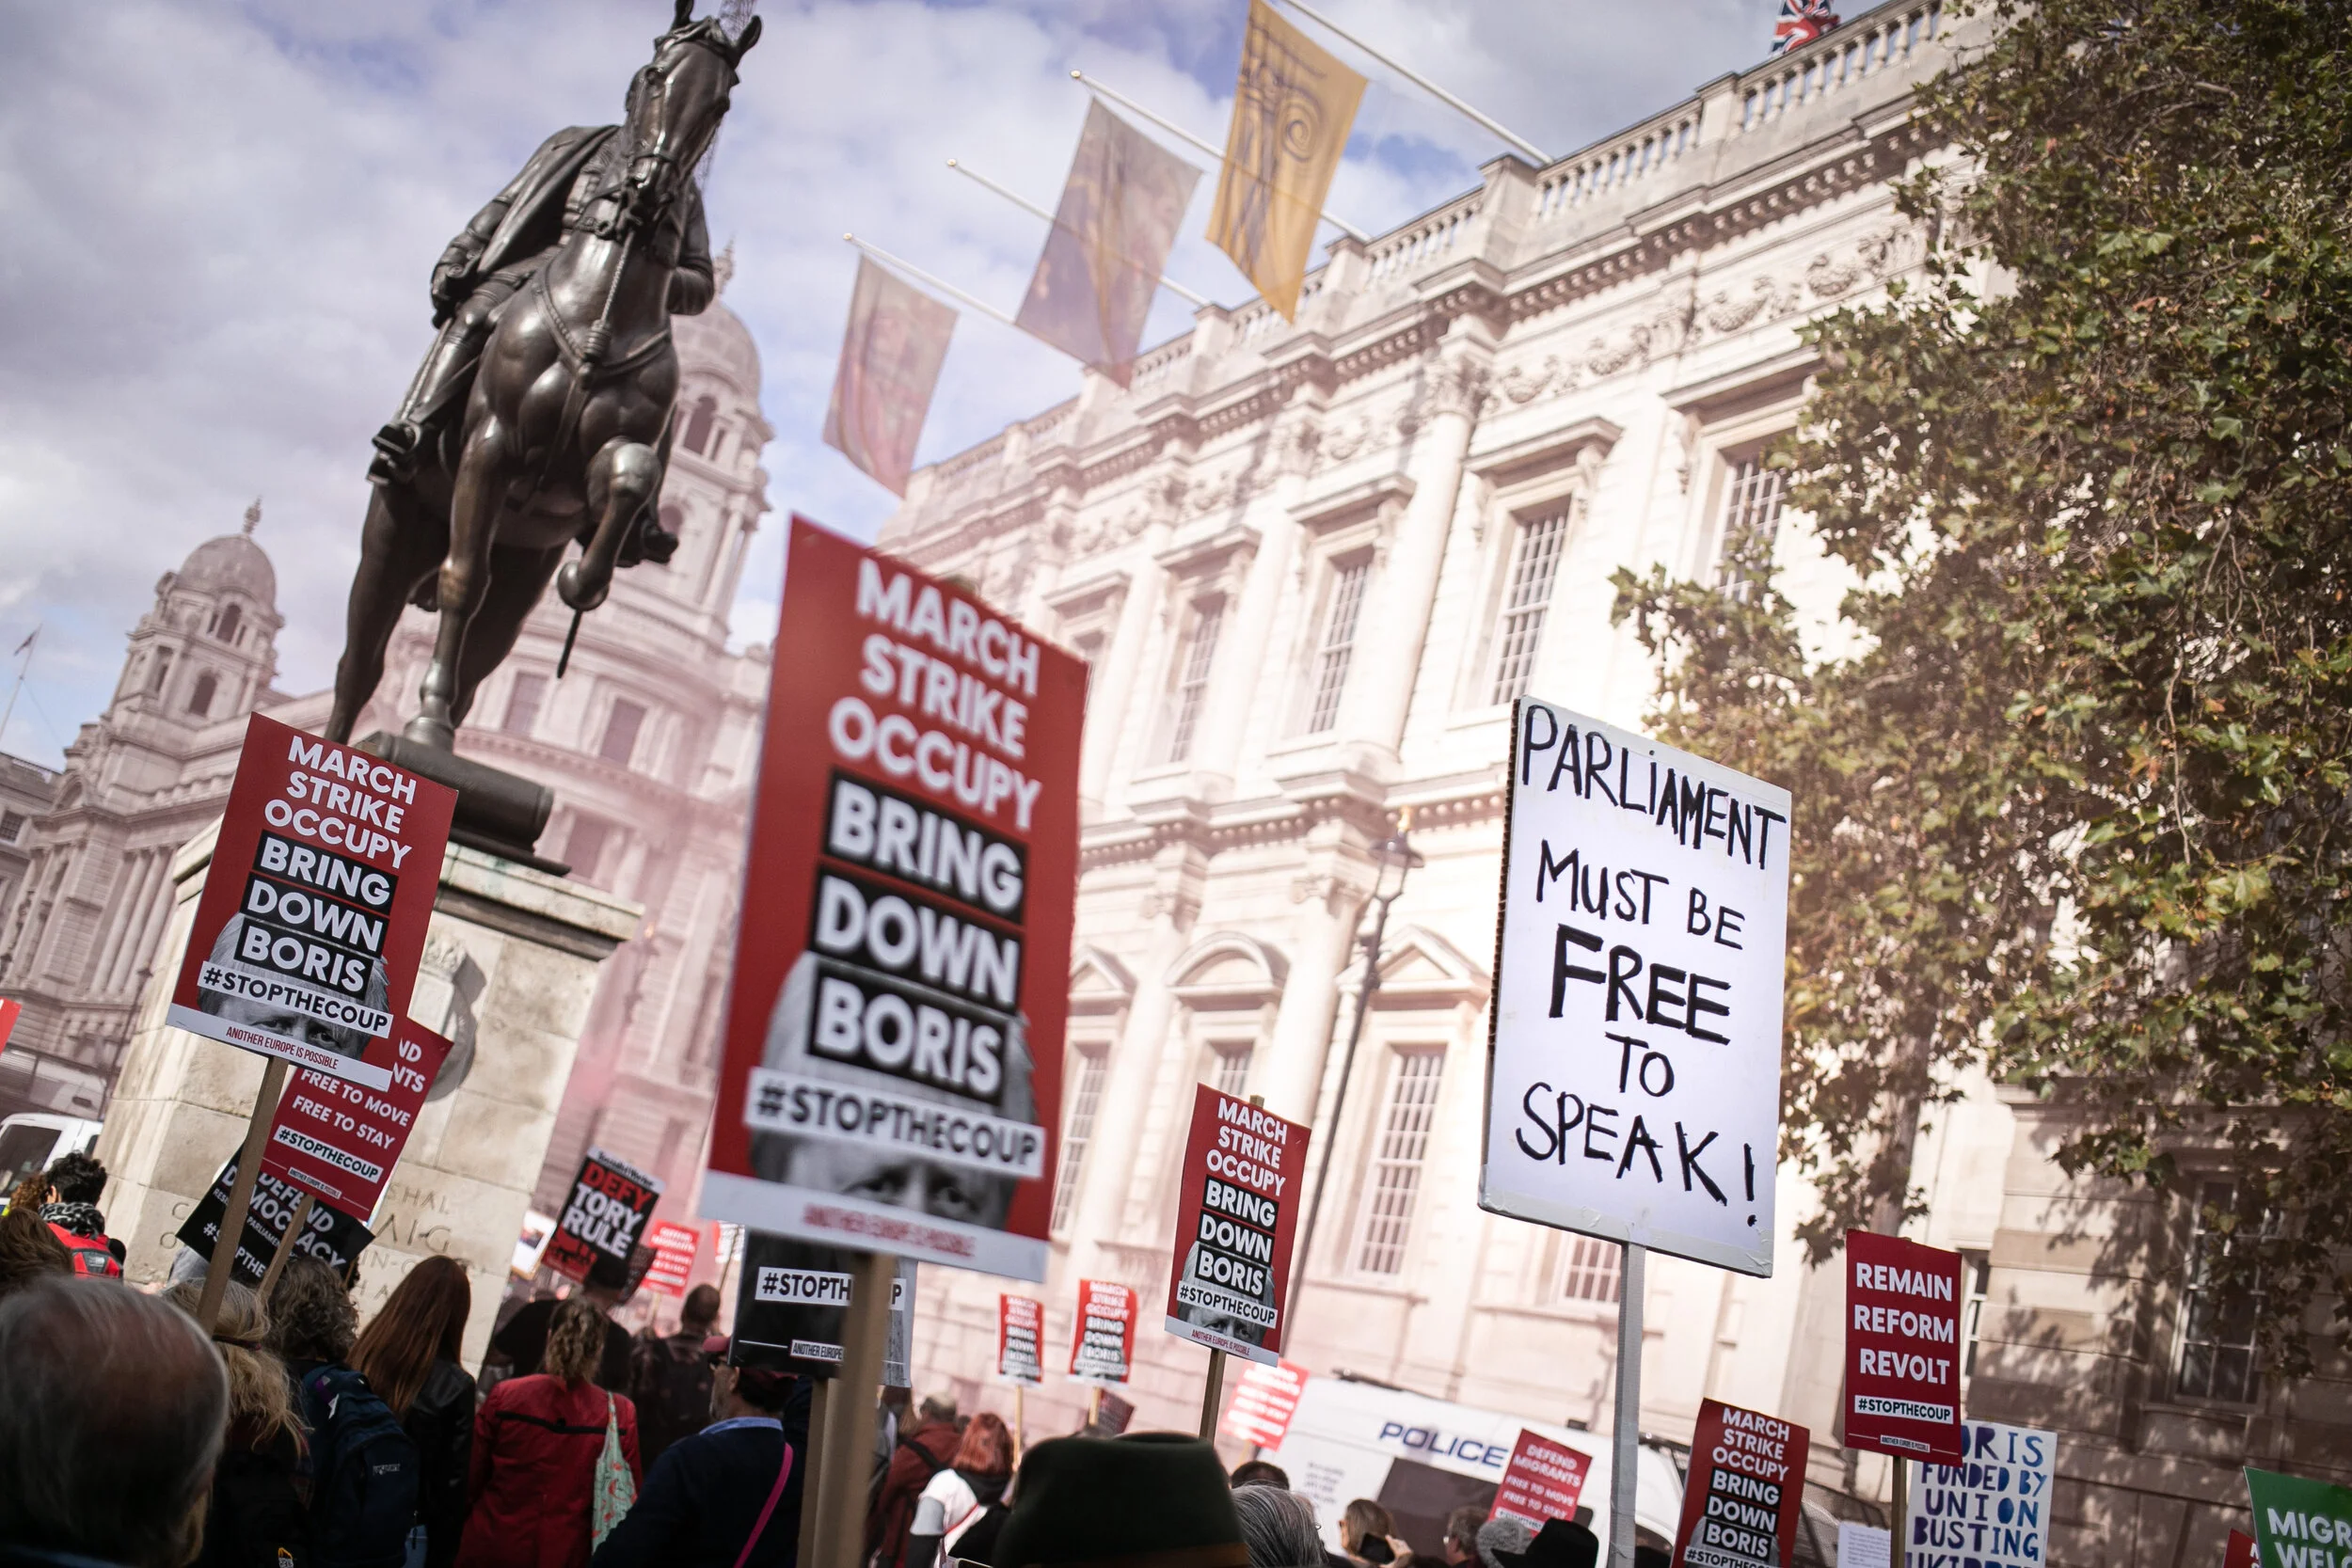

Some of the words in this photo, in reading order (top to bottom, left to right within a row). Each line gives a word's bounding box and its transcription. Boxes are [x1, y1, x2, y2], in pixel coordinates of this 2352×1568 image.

[858, 558, 1040, 695] MARCH
[860, 634, 1027, 758] STRIKE
[288, 736, 417, 804] MARCH
[829, 697, 1041, 830] OCCUPY
[286, 771, 405, 834] STRIKE
[264, 799, 412, 868] OCCUPY
[830, 779, 1023, 911] BRING
[261, 836, 390, 906] BRING
[1536, 838, 1669, 925] MUST
[1687, 887, 1745, 950] BE
[247, 879, 384, 952] DOWN
[242, 926, 365, 992] BORIS
[817, 876, 1019, 1004] DOWN
[203, 967, 388, 1032] #STOPTHECOUP
[1549, 923, 1731, 1045] FREE
[226, 1026, 264, 1046] ANOTHER
[264, 1037, 295, 1054] EUROPE
[295, 1046, 303, 1058] IS
[304, 1049, 339, 1069] POSSIBLE
[814, 977, 1001, 1095] BORIS
[1605, 1031, 1675, 1097] TO
[300, 1069, 337, 1094] FREE
[342, 1084, 363, 1104] TO
[365, 1096, 410, 1127] MOVE
[1218, 1098, 1287, 1145] MARCH
[292, 1096, 332, 1122] FREE
[333, 1113, 355, 1132] TO
[357, 1124, 395, 1149] STAY
[756, 1079, 1036, 1166] #STOPTHECOUP
[279, 1129, 378, 1178] #STOPTHECOUP
[1218, 1126, 1281, 1169] STRIKE
[581, 1161, 653, 1212] DEFY
[1206, 1149, 1286, 1196] OCCUPY
[577, 1181, 644, 1233] TORY
[1206, 1180, 1275, 1227] BRING
[563, 1206, 633, 1259] RULE
[1200, 1213, 1272, 1262] DOWN
[762, 1272, 901, 1305] #STOPTHP
[1199, 1250, 1263, 1295] BORIS
[1856, 1262, 1952, 1302] REMAIN
[1180, 1285, 1275, 1323] #STOPTHECOUP
[1854, 1305, 1954, 1343] REFORM
[793, 1342, 820, 1356] ANOTHER
[820, 1346, 843, 1360] EUROPE
[1860, 1348, 1950, 1385] REVOLT
[1723, 1407, 1789, 1442] MARCH
[1858, 1398, 1951, 1421] #STOPTHECOUP
[1379, 1421, 1509, 1468] POLICE
[1527, 1444, 1577, 1470] DEFEND
[1712, 1447, 1789, 1481] OCCUPY
[1724, 1429, 1785, 1461] STRIKE
[1505, 1475, 1529, 1490] FREE
[1530, 1481, 1545, 1495] TO
[1545, 1488, 1574, 1507] MOVE
[1513, 1454, 1581, 1487] MIGRANTS
[1712, 1469, 1779, 1505] BRING
[1922, 1462, 2010, 1492] FUNDED
[2019, 1470, 2047, 1497] BY
[1502, 1490, 1526, 1505] FREE
[1527, 1498, 1542, 1511] TO
[1542, 1504, 1567, 1519] STAY
[1708, 1496, 1776, 1532] DOWN
[1926, 1488, 2039, 1528] UNION
[1706, 1523, 1769, 1558] BORIS
[1914, 1516, 2039, 1561] BUSTING
